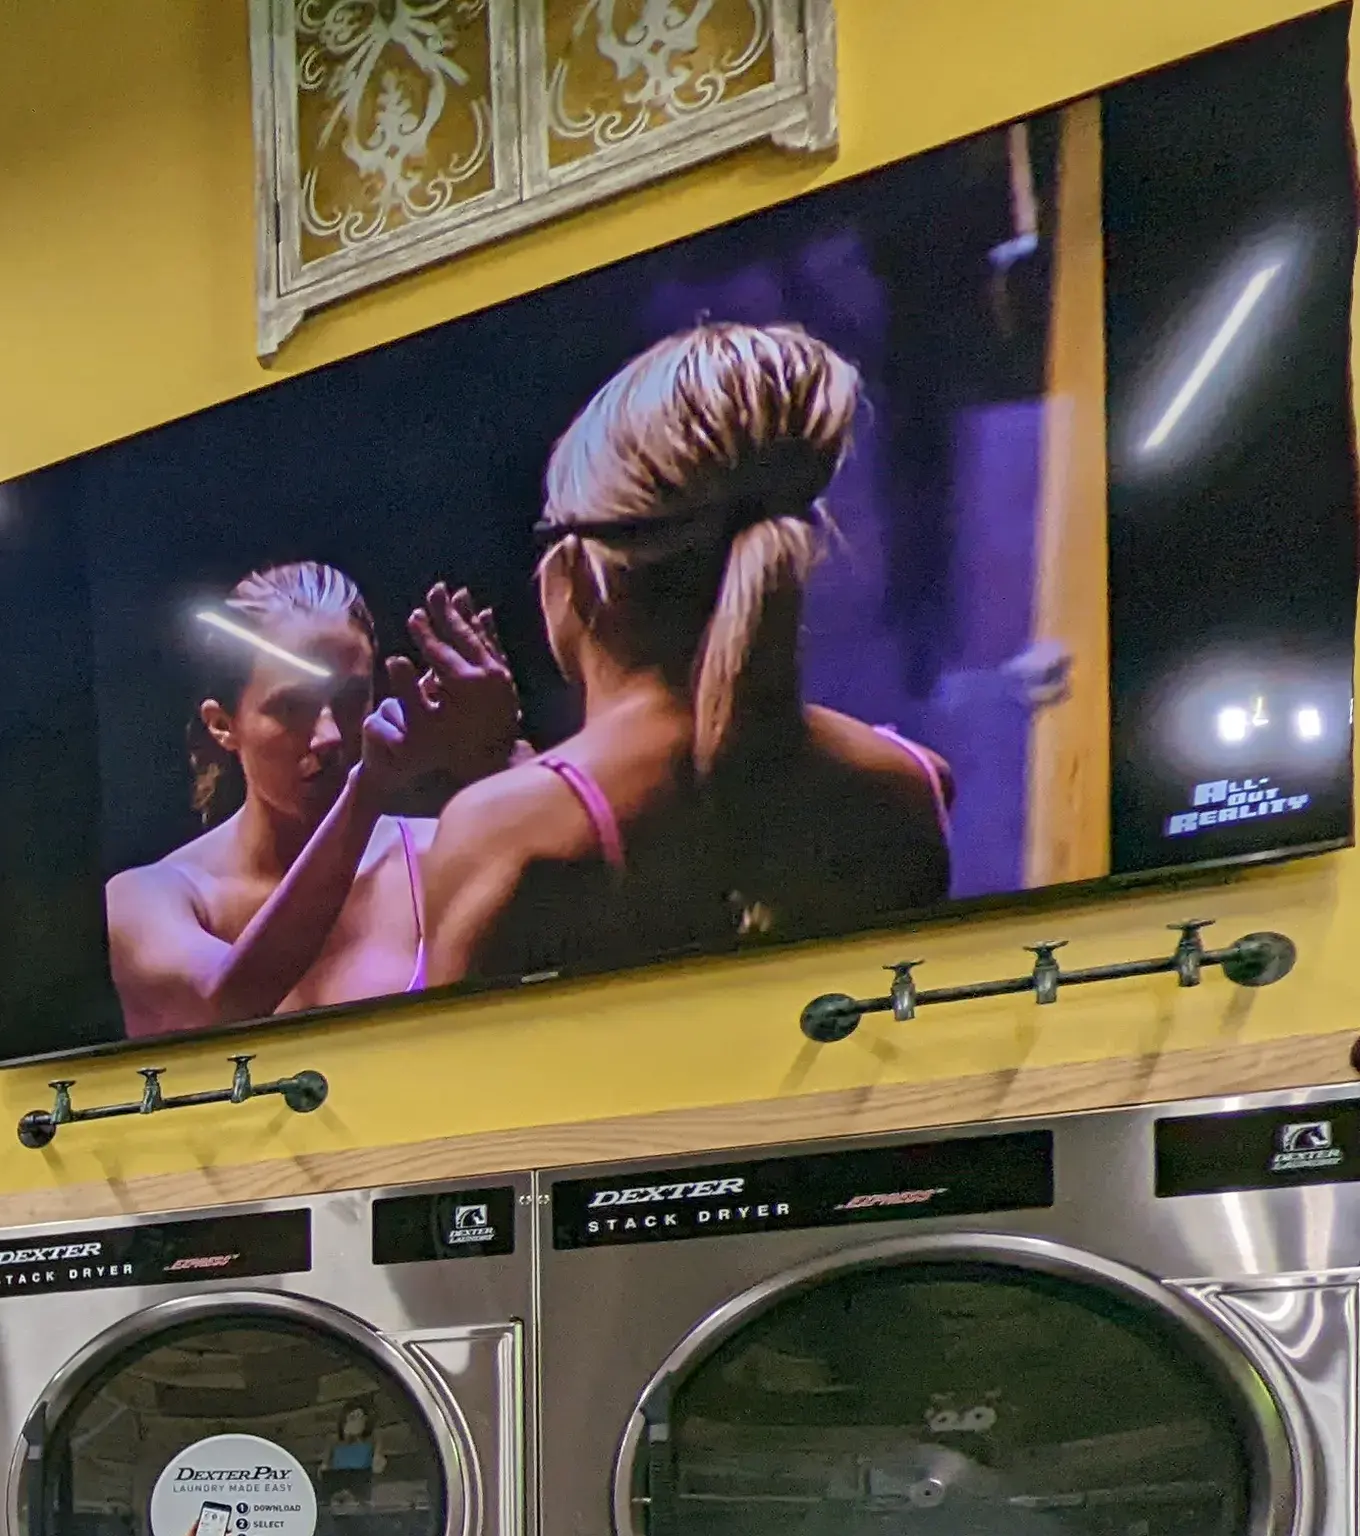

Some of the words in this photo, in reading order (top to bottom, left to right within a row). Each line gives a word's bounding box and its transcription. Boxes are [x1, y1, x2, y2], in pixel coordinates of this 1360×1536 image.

[1168, 794, 1309, 835] REALITY
[588, 1177, 745, 1209] DEXTER
[588, 1212, 679, 1233] STACK
[698, 1202, 791, 1223] DRYER
[448, 1227, 494, 1238] DEXTER
[68, 1263, 134, 1279] DRYER
[173, 1484, 224, 1493] LAUNDRY
[229, 1483, 260, 1492] MADE
[264, 1483, 293, 1492] EASY
[253, 1503, 301, 1513] DOWNLOAD
[253, 1519, 285, 1528] SELECT
